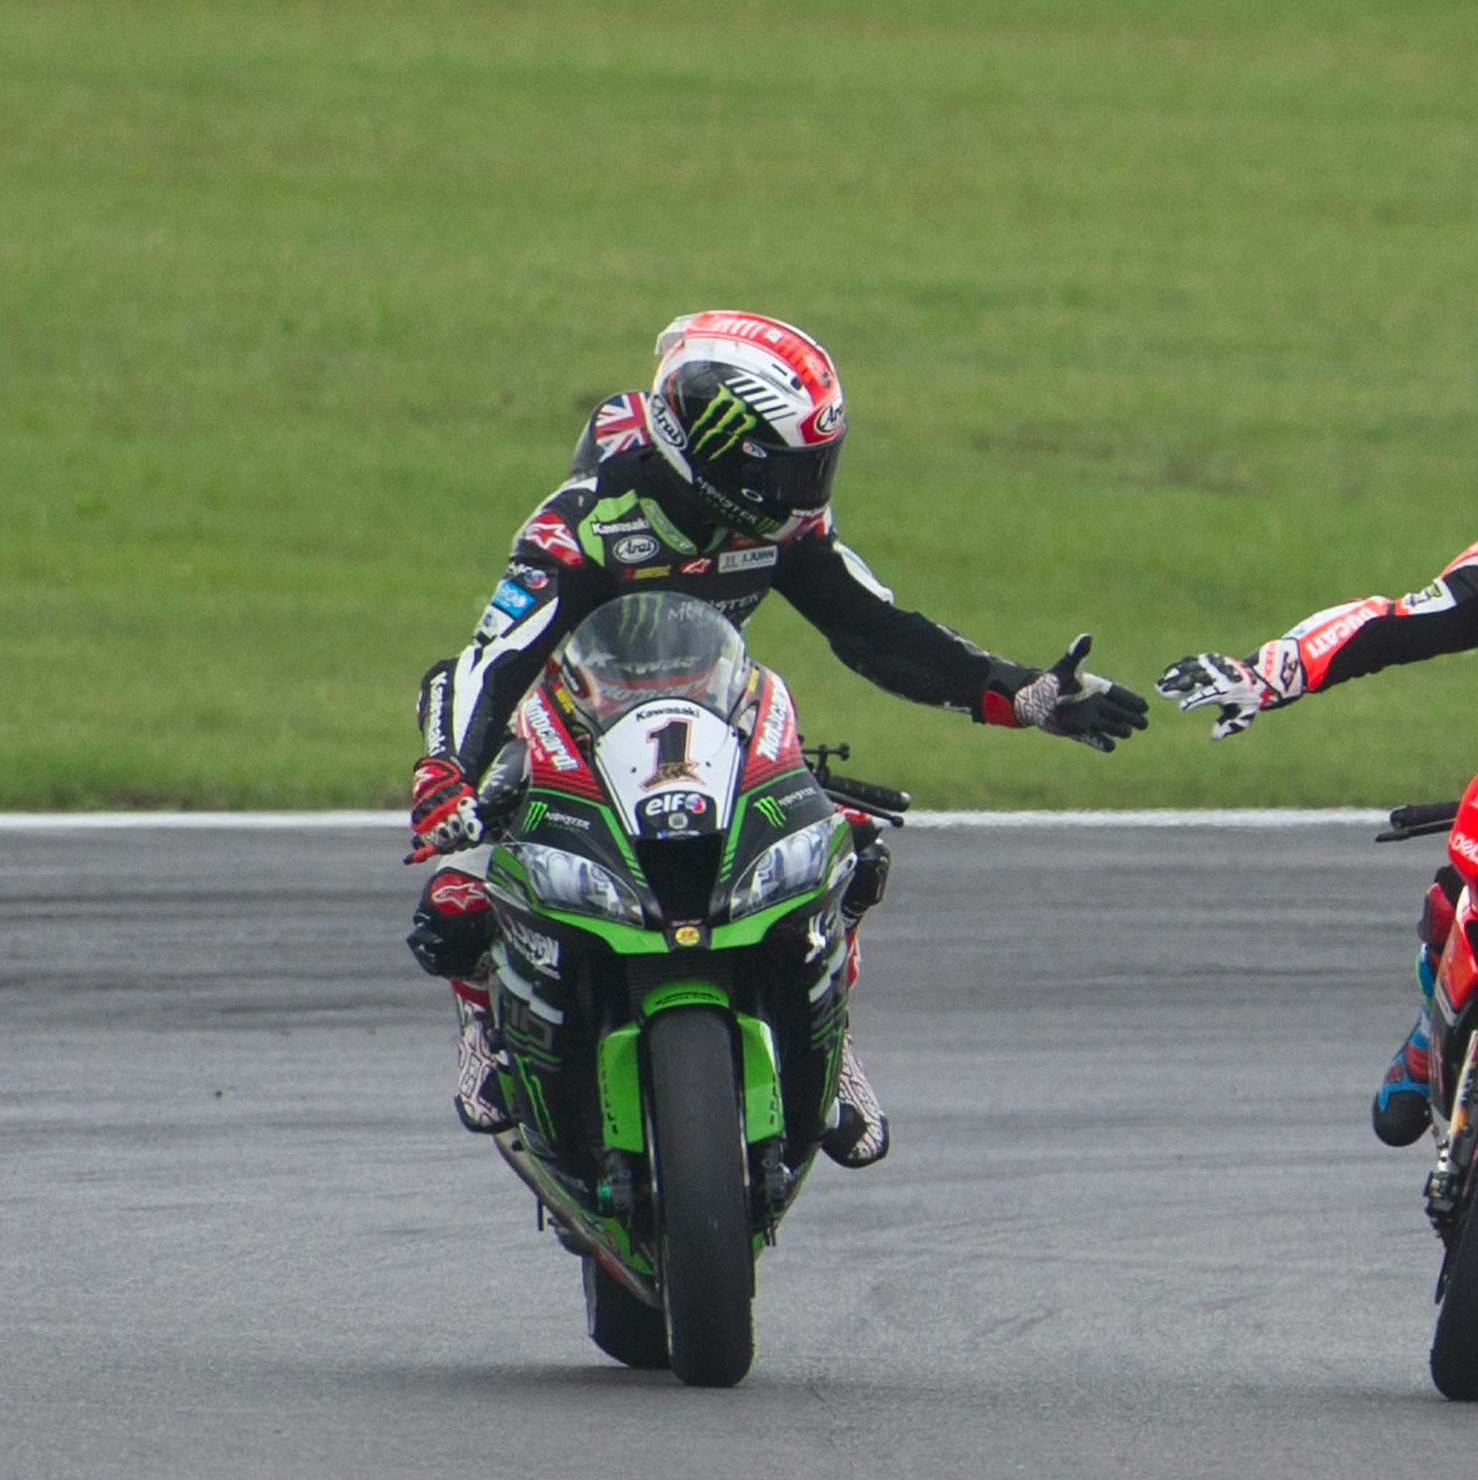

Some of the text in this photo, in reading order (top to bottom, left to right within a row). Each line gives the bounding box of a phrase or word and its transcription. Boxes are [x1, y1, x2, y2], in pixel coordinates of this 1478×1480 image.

[653, 400, 685, 446] Arai
[1305, 606, 1377, 659] DUCATI
[635, 706, 701, 722] Kawasaki
[638, 716, 706, 792] 1
[644, 793, 686, 817] elf
